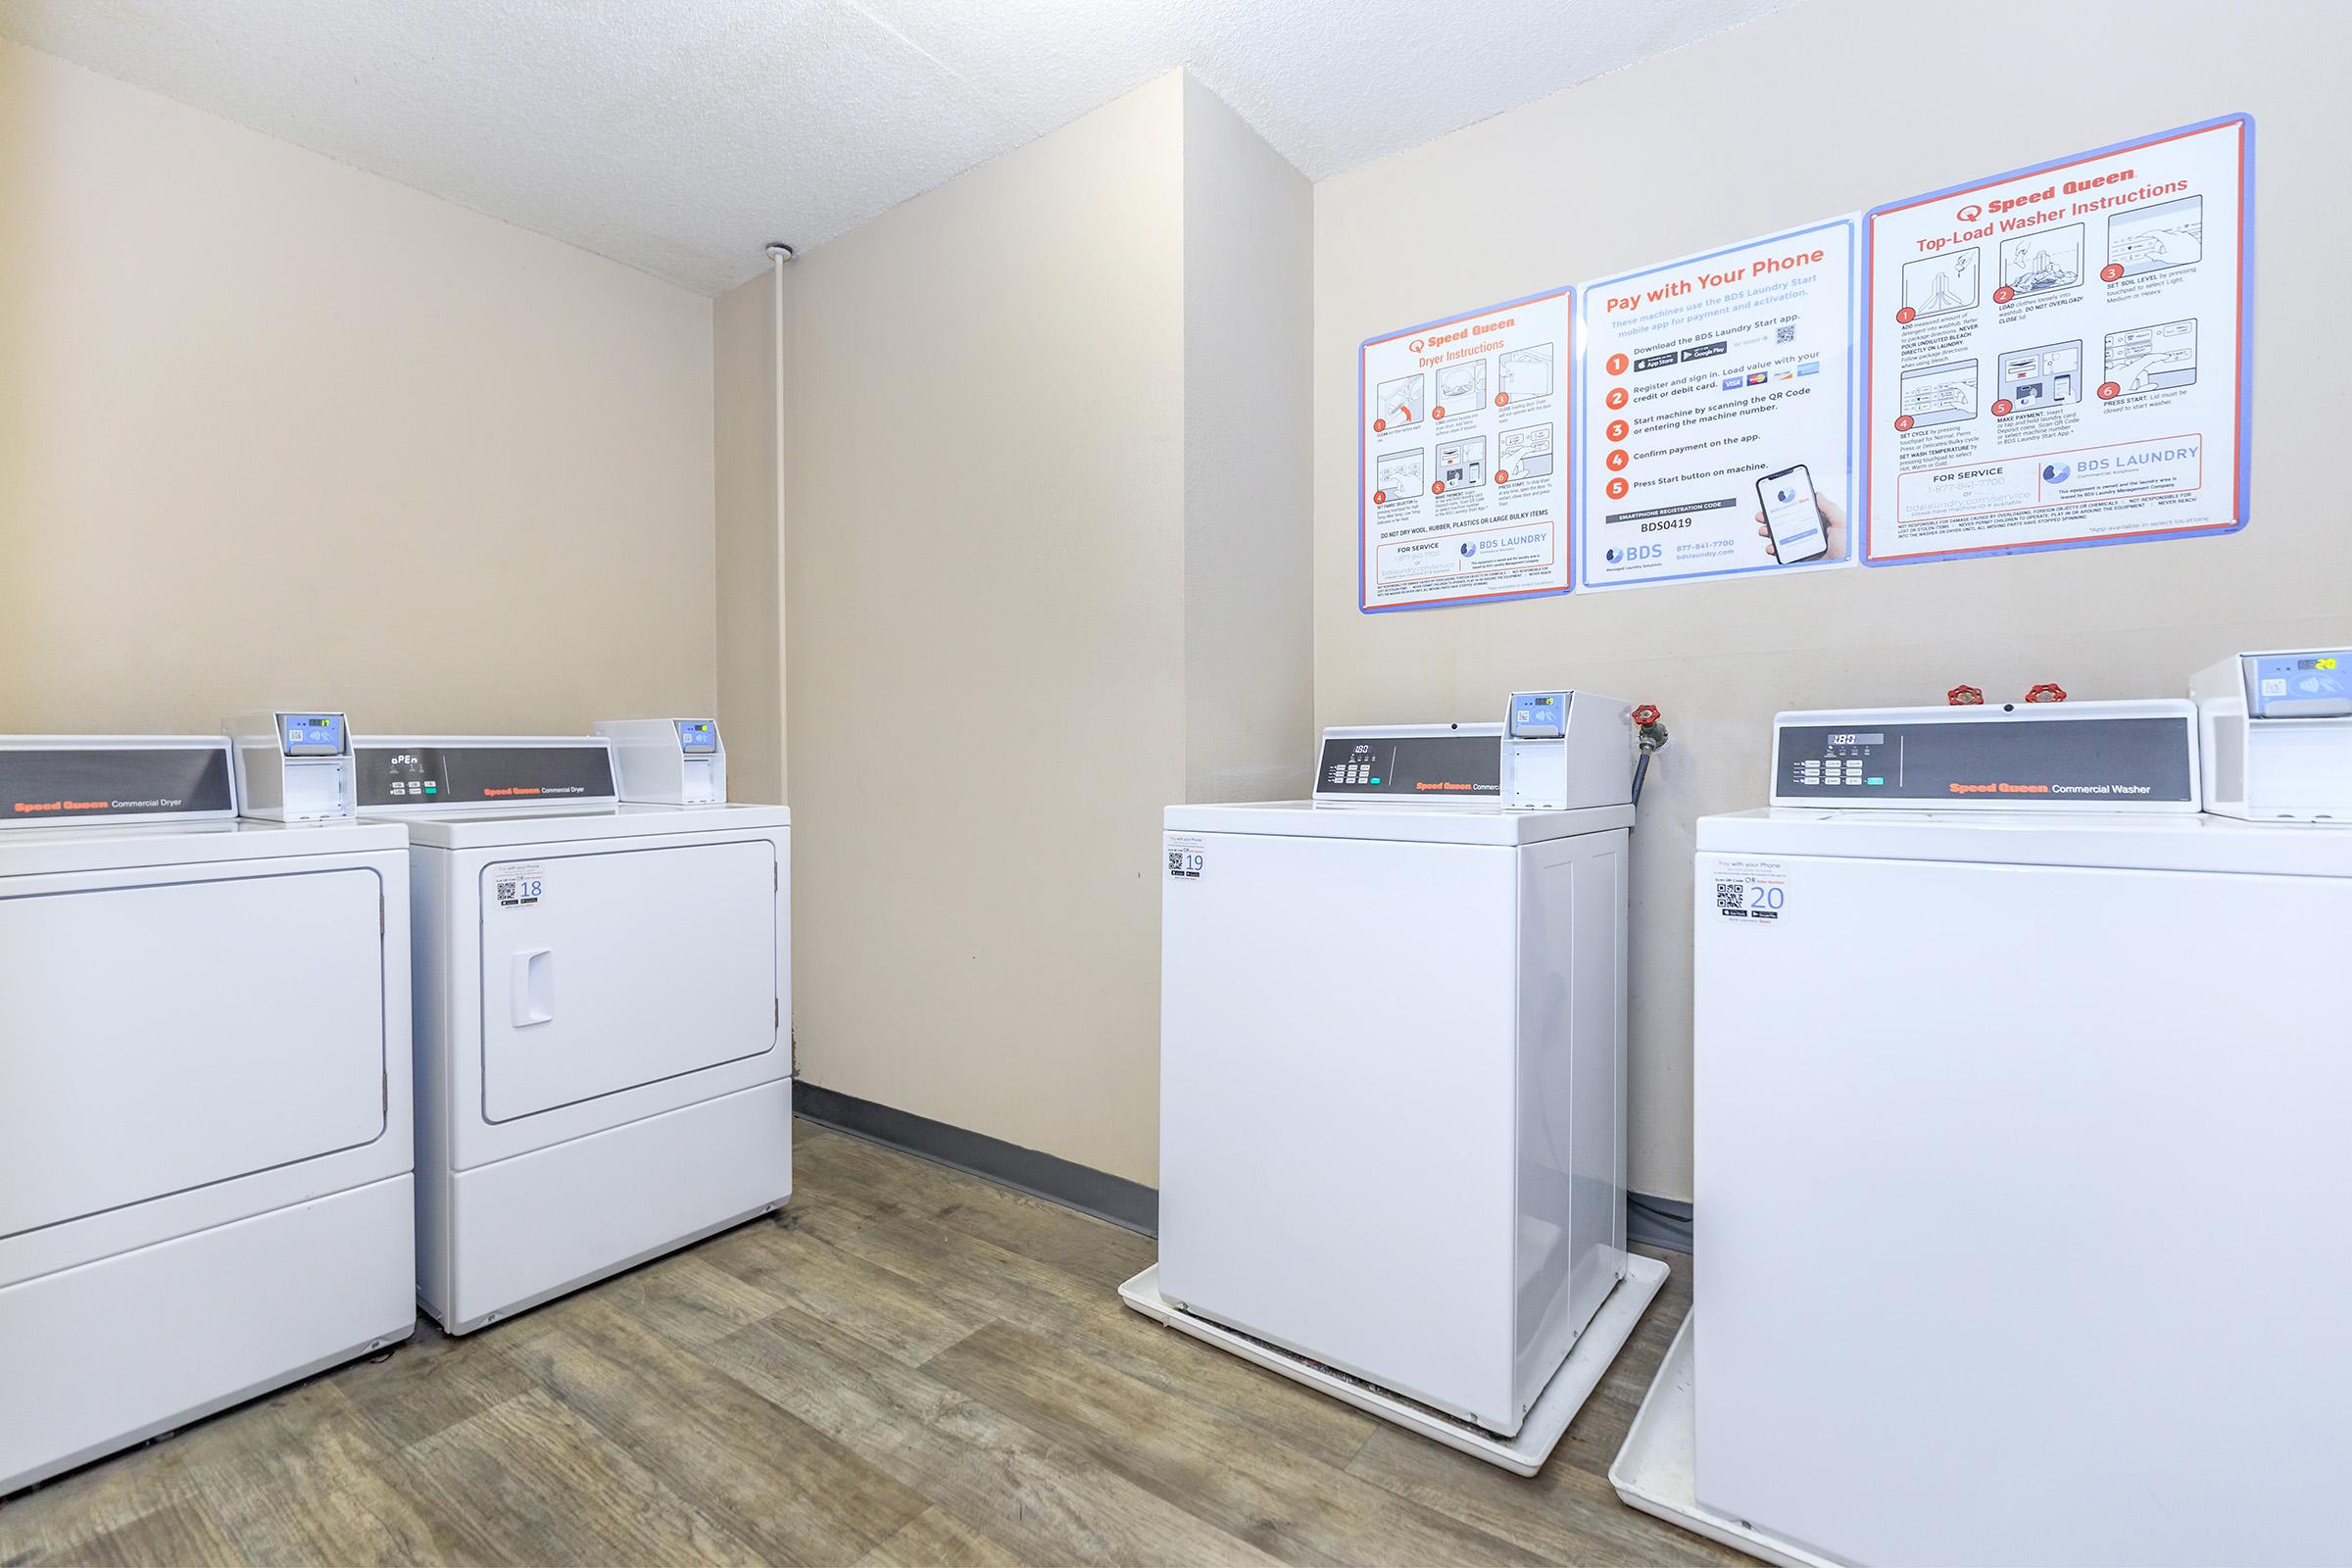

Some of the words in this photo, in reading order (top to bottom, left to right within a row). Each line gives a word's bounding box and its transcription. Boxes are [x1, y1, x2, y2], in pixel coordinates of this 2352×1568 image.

[1988, 187, 2055, 215] Speed
[2062, 168, 2135, 195] Queen
[1916, 222, 1993, 252] Top-Load
[2000, 206, 2065, 233] Washer
[2072, 179, 2188, 216] Instructions
[1607, 294, 1641, 313] Pay
[1647, 280, 1691, 302] with
[1698, 269, 1745, 289] Your
[1752, 250, 1824, 277] Phone
[1612, 318, 1638, 329] These
[1640, 307, 1684, 323] machines
[1687, 302, 1702, 311] use
[1706, 297, 1721, 305] the
[1725, 291, 1743, 302] BDS
[1747, 282, 1788, 296] Laundry
[1791, 274, 1816, 286] Start
[1619, 325, 1648, 338] mobile
[1652, 321, 1668, 331] app
[1671, 317, 1684, 326] for
[1687, 307, 1729, 323] payment
[1732, 301, 1751, 311] and
[1754, 289, 1808, 307] activation.
[1428, 328, 1468, 347] Speed
[1472, 318, 1515, 335] Queen
[1634, 340, 1676, 355] Download
[1678, 337, 1692, 345] the
[1695, 332, 1713, 342] BDS
[1715, 323, 1752, 337] Laundry
[1755, 318, 1777, 328] Start
[1780, 314, 1800, 324] app.
[1419, 355, 1444, 368] Dryer
[1446, 340, 1504, 361] Instructions
[1633, 381, 1668, 393] Register
[1671, 376, 1687, 386] and
[1690, 373, 1707, 383] sign
[1723, 366, 1744, 375] Load
[1747, 361, 1771, 370] value
[1774, 355, 1795, 365] with
[1798, 352, 1819, 362] your
[1612, 392, 1622, 405] 2
[1633, 393, 1658, 403] credit
[1671, 385, 1693, 395] debit
[1696, 382, 1717, 391] card.
[1634, 416, 1654, 425] Start
[1656, 409, 1692, 421] machine
[1695, 406, 1706, 414] by
[1708, 398, 1748, 412] scanning
[1769, 392, 1783, 401] QR
[1786, 387, 1811, 397] Code
[1644, 421, 1680, 433] entering
[1699, 411, 1737, 423] machine
[1740, 404, 1777, 416] number.
[1613, 424, 1623, 437] 3
[1634, 449, 1666, 460] Confirm
[1669, 442, 1707, 455] payment
[1724, 437, 1738, 445] the
[1741, 434, 1761, 443] app.
[1613, 454, 1622, 466] 4
[2077, 459, 2109, 472] BDS
[2117, 446, 2199, 467] LAUNDRY
[1658, 476, 1679, 484] Start
[1681, 471, 1711, 481] button
[1727, 463, 1768, 474] machine.
[1933, 474, 1955, 483] FOR
[1958, 467, 2004, 480] SERVICE
[1613, 482, 1622, 494] 5
[1619, 510, 1659, 520] SMARTPHONE
[1660, 504, 1703, 515] REGISTRATION
[1411, 526, 1428, 535] WOOL,
[1429, 523, 1452, 532] RUBBER,
[1453, 518, 1480, 529] PLASTICS
[1490, 514, 1508, 523] LARGE
[1510, 512, 1529, 520] BULKY
[1530, 509, 1549, 518] ITEMS
[1641, 517, 1692, 533] BDS0419
[1412, 542, 1439, 551] SERVICE
[1479, 539, 1498, 549] BDS
[1501, 533, 1546, 546] LAUNDRY
[1677, 539, 1734, 552] 877-841-7700
[1627, 543, 1663, 561] BDS
[1676, 549, 1735, 561] bdslaundry.com
[484, 788, 512, 797] Speed
[1416, 782, 1443, 791] Speed
[1444, 782, 1471, 790] Queen
[1949, 783, 1996, 794] Speed
[1998, 783, 2049, 793] Queen
[2052, 784, 2110, 794] Commercial
[2112, 785, 2151, 794] Washer
[15, 800, 61, 813] Speed
[63, 800, 110, 810] Queen
[111, 799, 158, 808] Commercial
[160, 798, 182, 808] Dryer
[1186, 855, 1203, 871] 19
[520, 881, 541, 897] 18
[1750, 886, 1784, 909] 20
